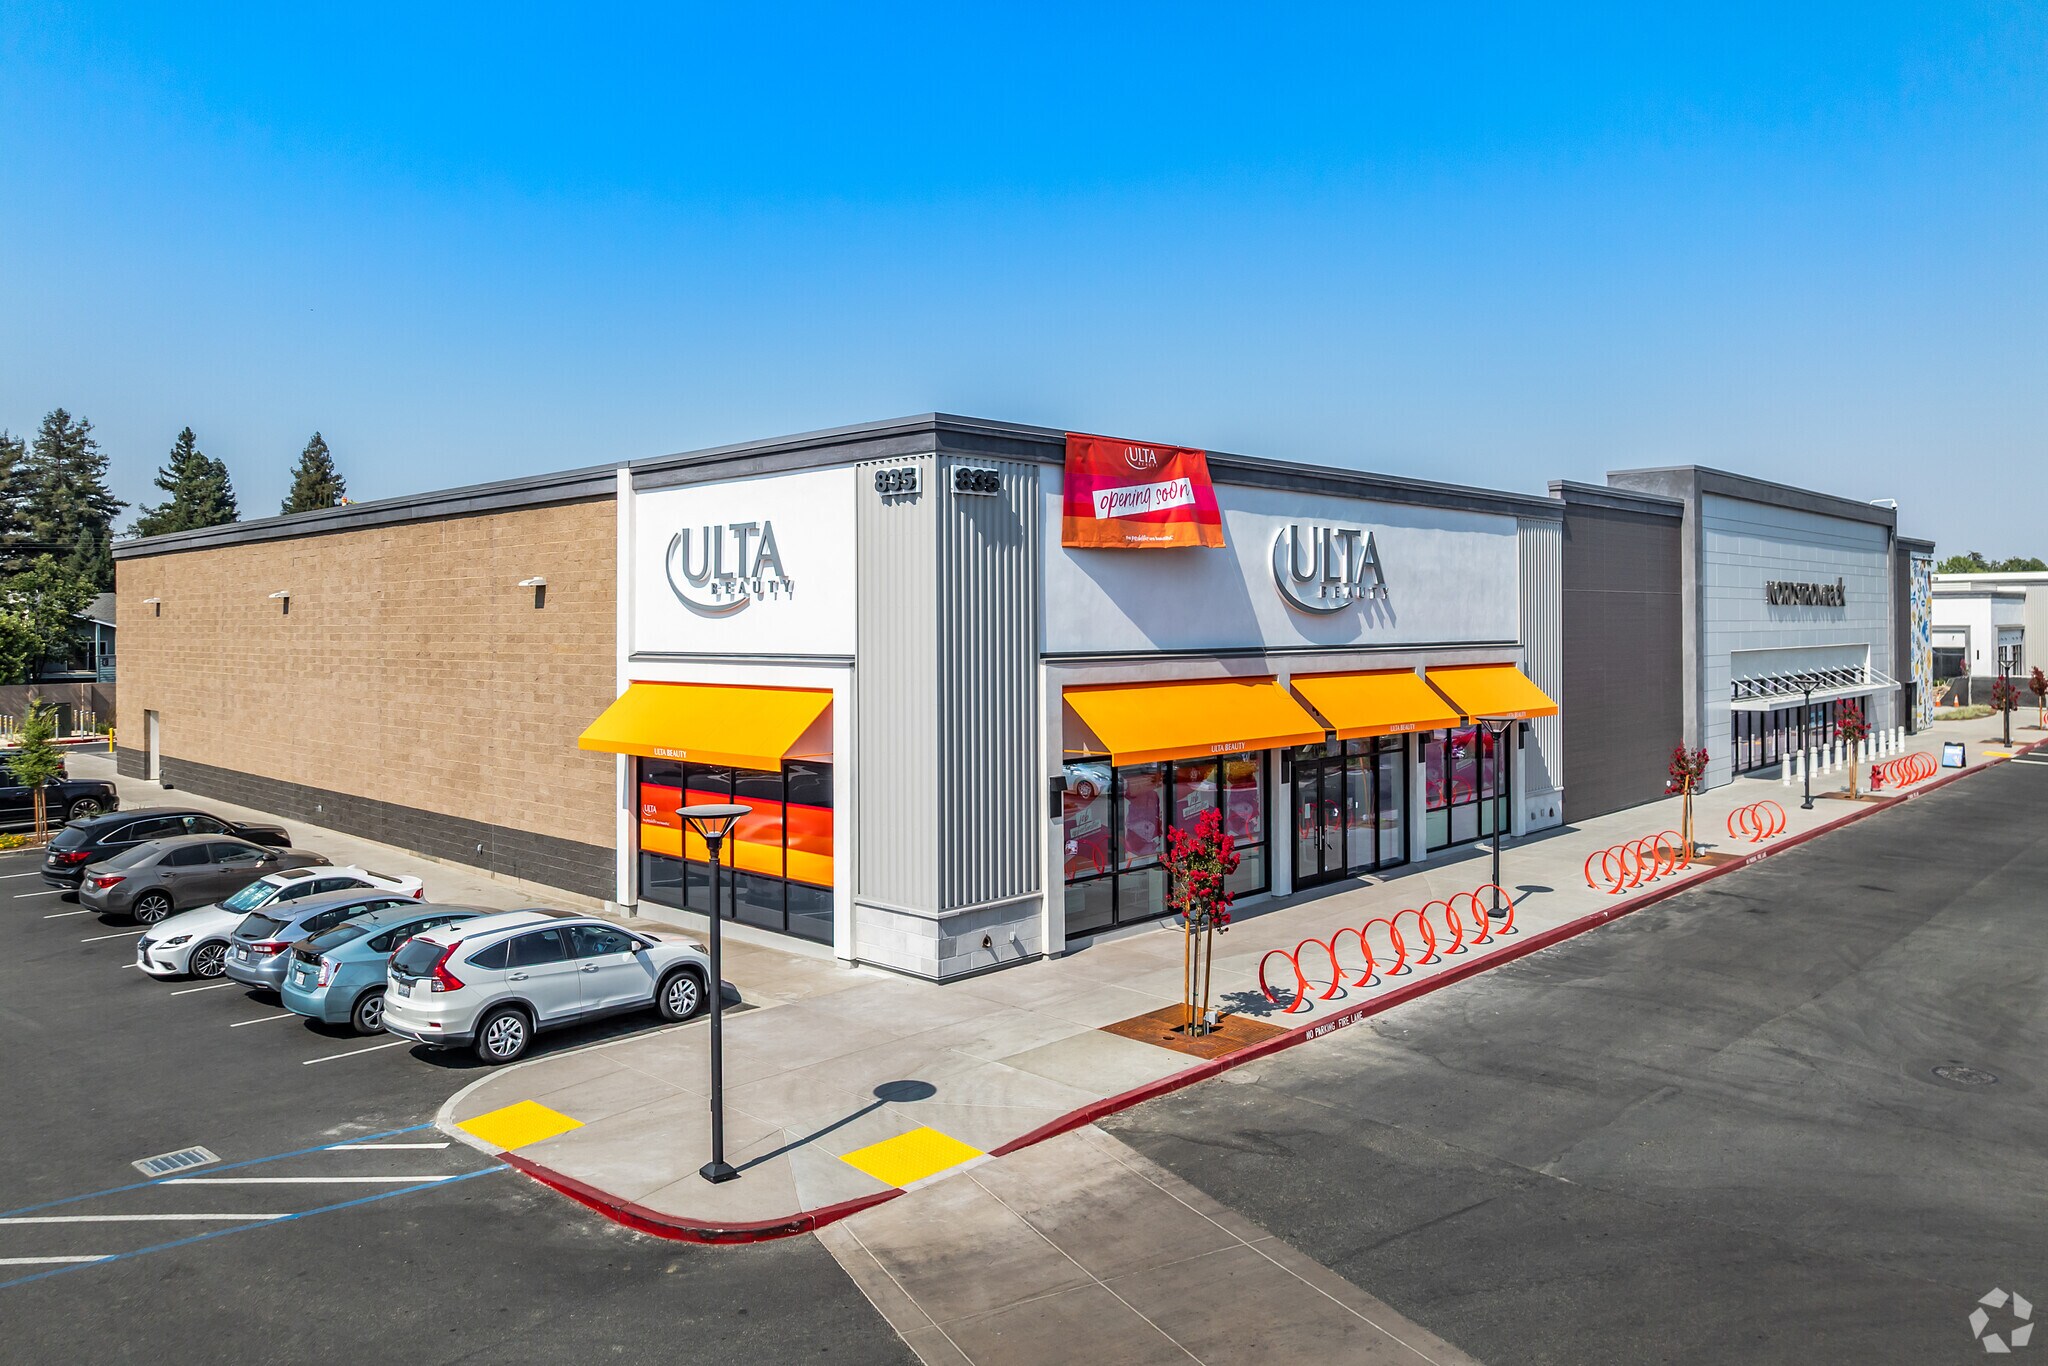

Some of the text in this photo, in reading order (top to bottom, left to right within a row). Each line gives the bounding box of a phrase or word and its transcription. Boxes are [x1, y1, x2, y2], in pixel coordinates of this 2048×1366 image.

[1128, 446, 1157, 464] ULTA
[875, 467, 916, 492] 835
[955, 467, 1000, 493] 835
[1100, 481, 1190, 518] opening soon
[682, 520, 787, 584] ULTA
[1286, 524, 1386, 585] ULTA
[711, 579, 795, 598] BEAUTY
[1317, 586, 1390, 600] BEAUTY
[654, 747, 687, 758] ULTA BEAUTY
[1211, 742, 1245, 753] ULTA BEAUTY
[1306, 1010, 1364, 1040] NO PARKING FIRE LANE
